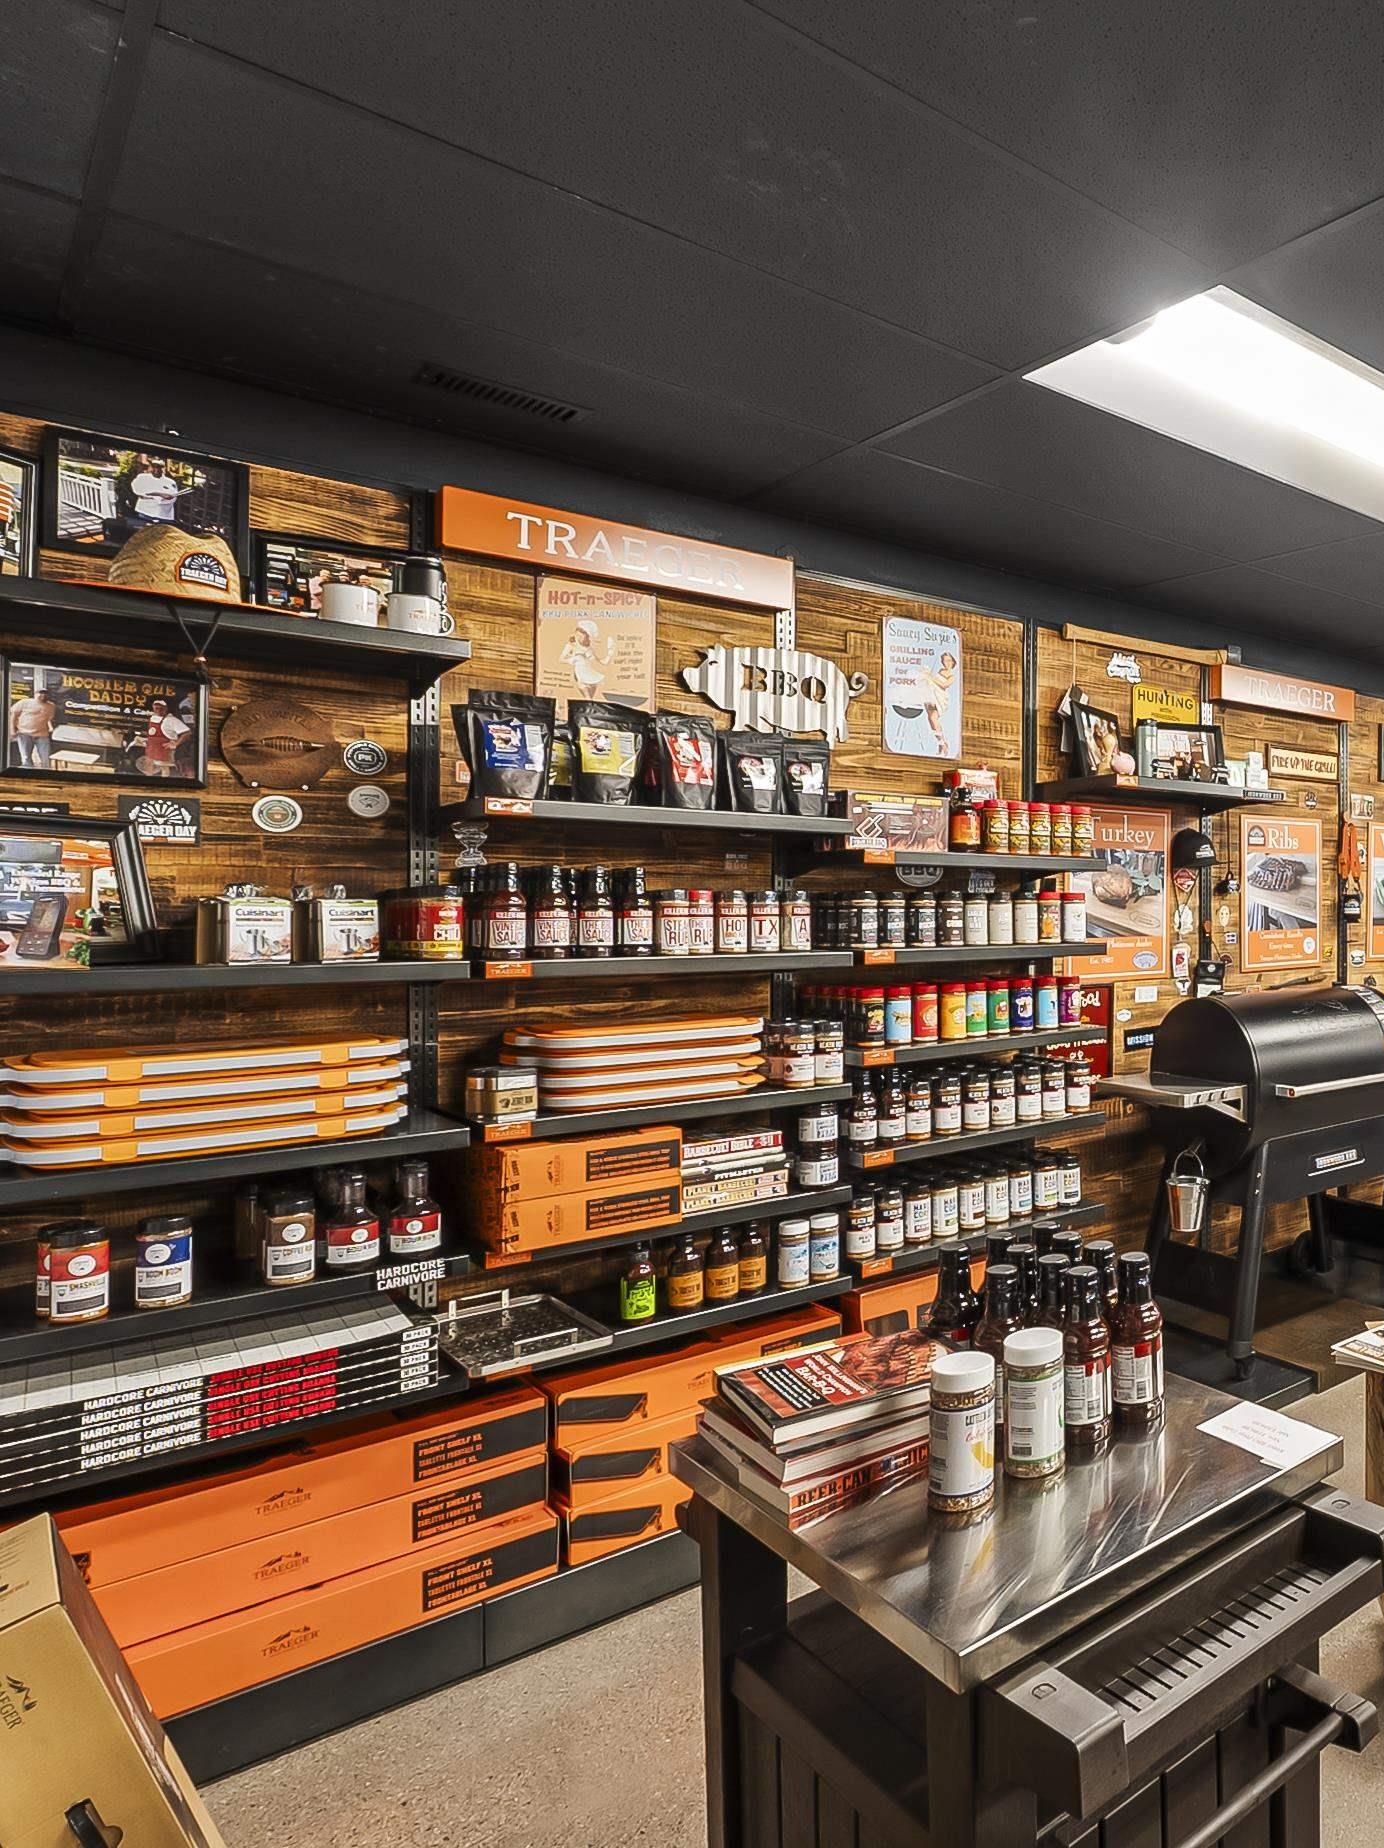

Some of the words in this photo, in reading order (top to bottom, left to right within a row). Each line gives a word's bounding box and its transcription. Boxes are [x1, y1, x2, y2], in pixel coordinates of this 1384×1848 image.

[506, 511, 745, 592] TRAEGER
[61, 674, 137, 693] HOOSIER
[740, 663, 827, 705] BBQ
[1244, 674, 1336, 713] TRAEGER
[89, 690, 147, 707] DADDY
[1138, 688, 1194, 711] HUNTING
[138, 824, 175, 837] AEGER
[174, 826, 198, 837] DAY
[1267, 826, 1300, 850] Ribs
[235, 907, 285, 917] Cuisinart
[328, 908, 375, 918] Cuisinart
[376, 1257, 447, 1281] HARDCORE
[377, 1267, 447, 1291] CARNIVORE
[83, 1390, 146, 1411] HARDCORE
[145, 1377, 205, 1398] CARNIVORE
[81, 1405, 143, 1426] HARDCORE
[143, 1391, 202, 1412] CARNIVORE
[80, 1419, 141, 1442] HARDCORE
[142, 1406, 200, 1428] CARNIVORE
[80, 1433, 142, 1455] HARDCORE
[143, 1419, 202, 1441] CARNIVORE
[80, 1448, 143, 1470] HARDCORE
[143, 1432, 202, 1454] CARNIVORE
[255, 1491, 313, 1515] TRAEGER
[253, 1555, 312, 1581] TRAEGER
[260, 1628, 321, 1658] TRAEGER
